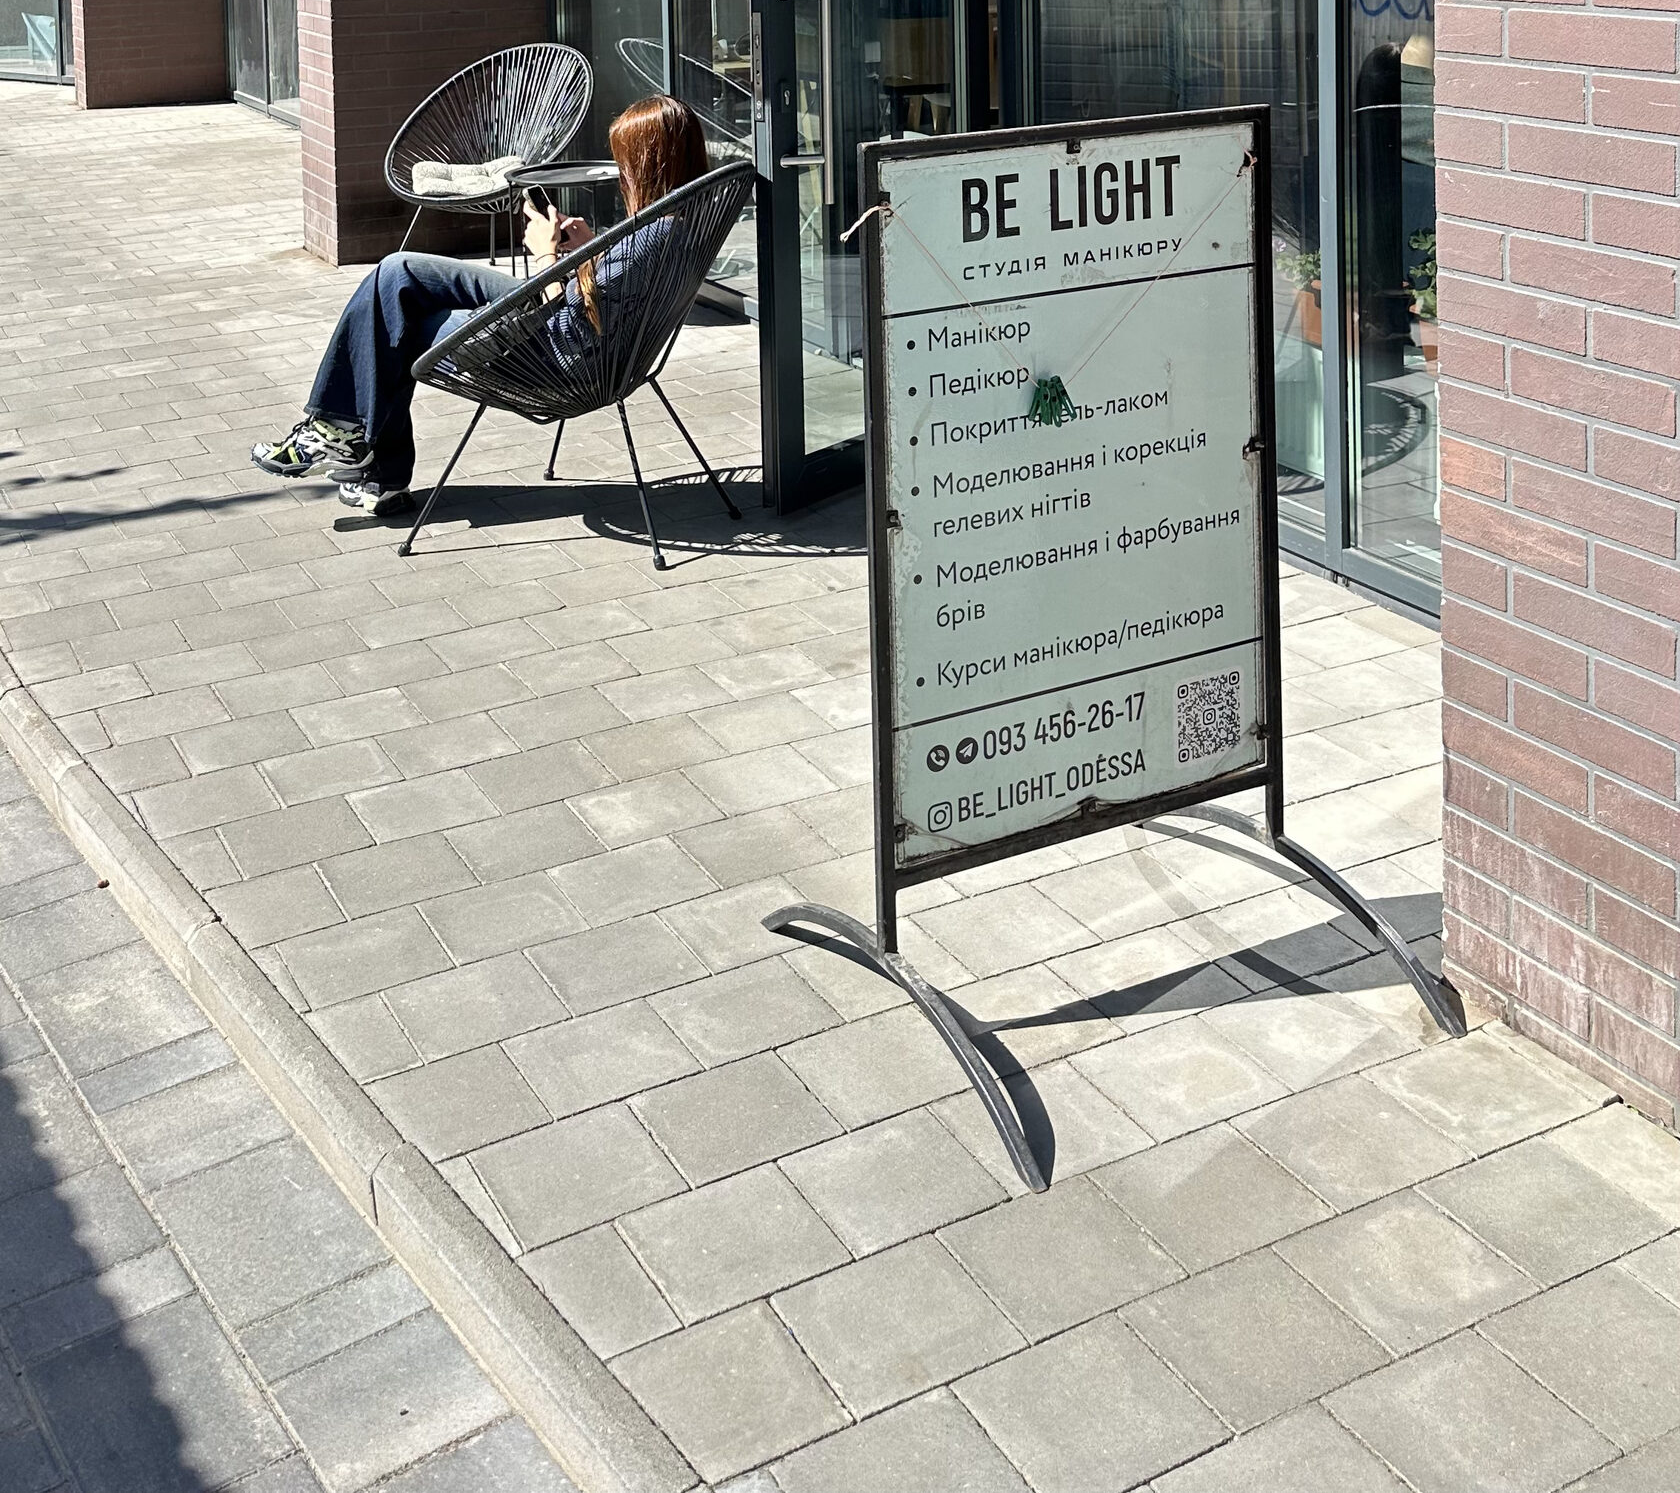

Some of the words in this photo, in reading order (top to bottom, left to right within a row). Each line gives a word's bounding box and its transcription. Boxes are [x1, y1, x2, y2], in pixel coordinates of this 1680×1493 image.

[961, 172, 1021, 244] BE
[1049, 154, 1181, 232] LIGHT
[963, 256, 1047, 281] СТУДІЯ
[1063, 238, 1183, 268] МАНІКЮРУ
[928, 318, 1031, 352] Манікюр
[929, 365, 1030, 399] Педікюр
[1048, 390, 1169, 427] ель-лаком
[932, 450, 1095, 499] Моделювання
[1102, 444, 1106, 467] і
[1114, 428, 1207, 465] корекція
[933, 503, 1024, 538] гелевих
[1030, 489, 1091, 520] нігтів
[936, 540, 1098, 588] Моделювання
[1105, 532, 1110, 552] і
[1116, 508, 1241, 554] фарбування
[936, 600, 985, 632] брів
[937, 656, 1006, 688] Курси
[983, 721, 1026, 760] 093
[1034, 691, 1146, 745] 456-26-17
